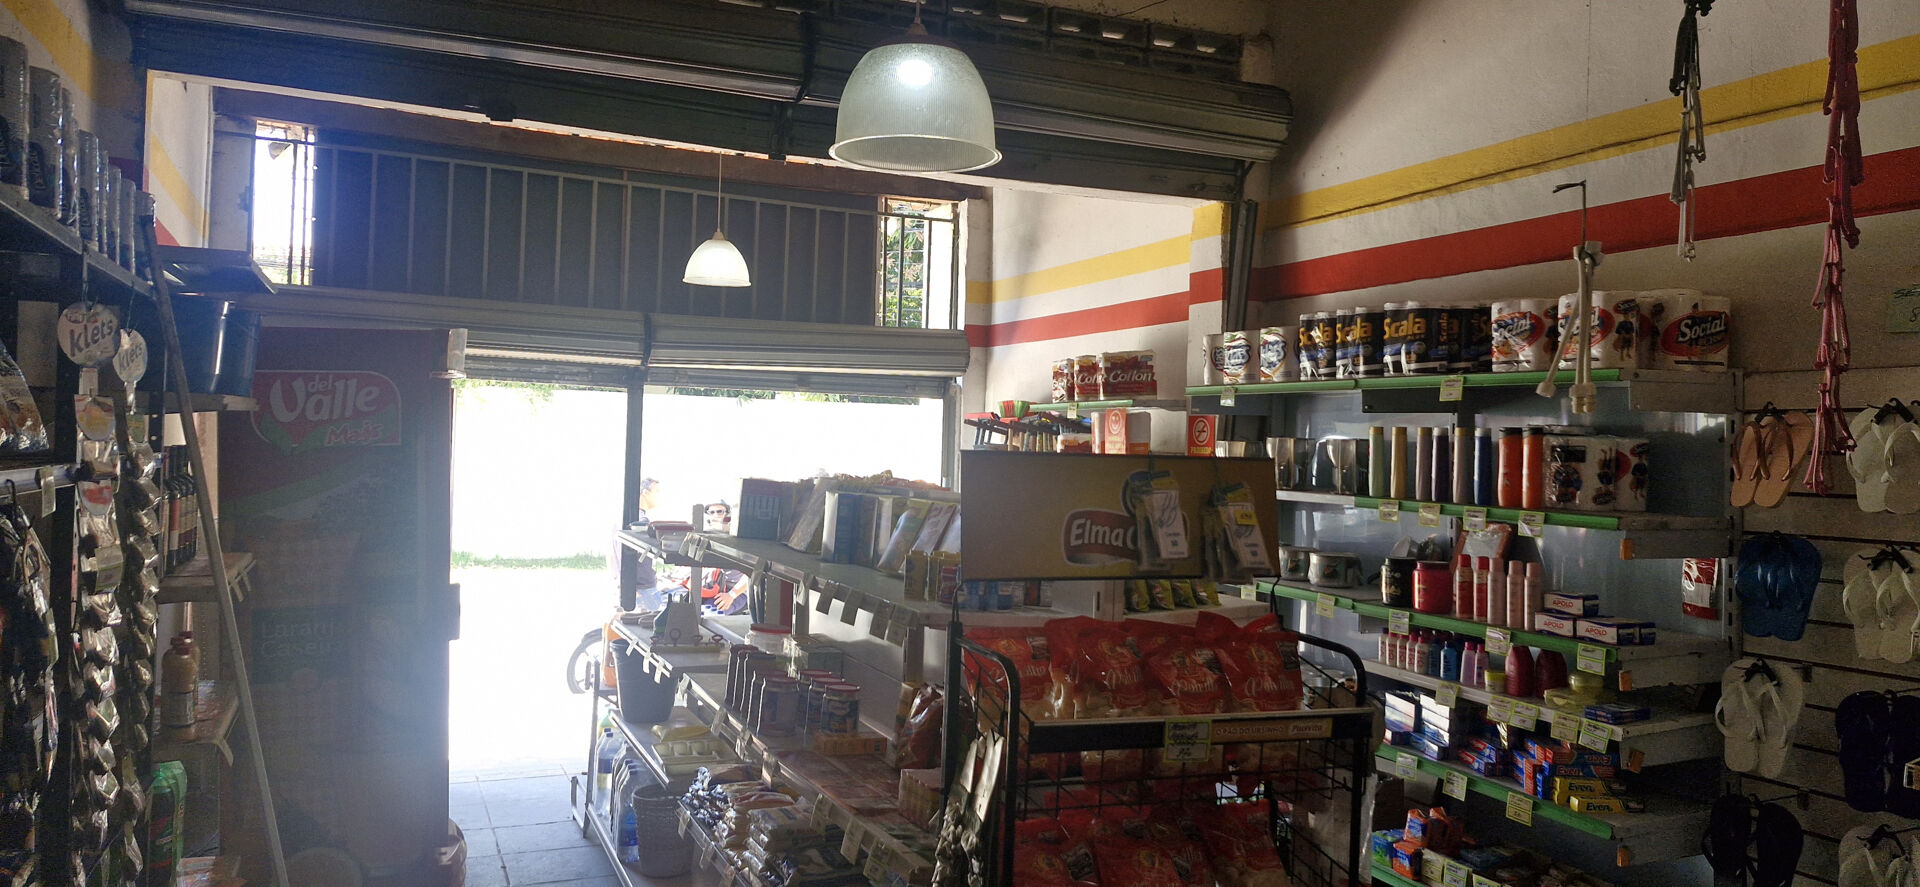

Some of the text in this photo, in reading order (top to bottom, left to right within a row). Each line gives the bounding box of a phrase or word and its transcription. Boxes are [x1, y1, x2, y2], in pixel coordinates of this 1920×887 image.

[69, 319, 113, 357] klets
[1299, 322, 1333, 347] Scla
[1336, 317, 1372, 344] Scala
[1384, 312, 1426, 340] Scala
[1678, 313, 1727, 342] Social
[308, 374, 334, 392] del
[269, 376, 382, 424] Valle
[325, 419, 384, 447] Mais
[1070, 517, 1125, 548] Elma
[1552, 600, 1574, 608] APOLO
[1543, 621, 1564, 629] APOLO
[1585, 627, 1608, 636] APOLO
[1568, 782, 1595, 793] Even
[1586, 802, 1613, 812] Even
